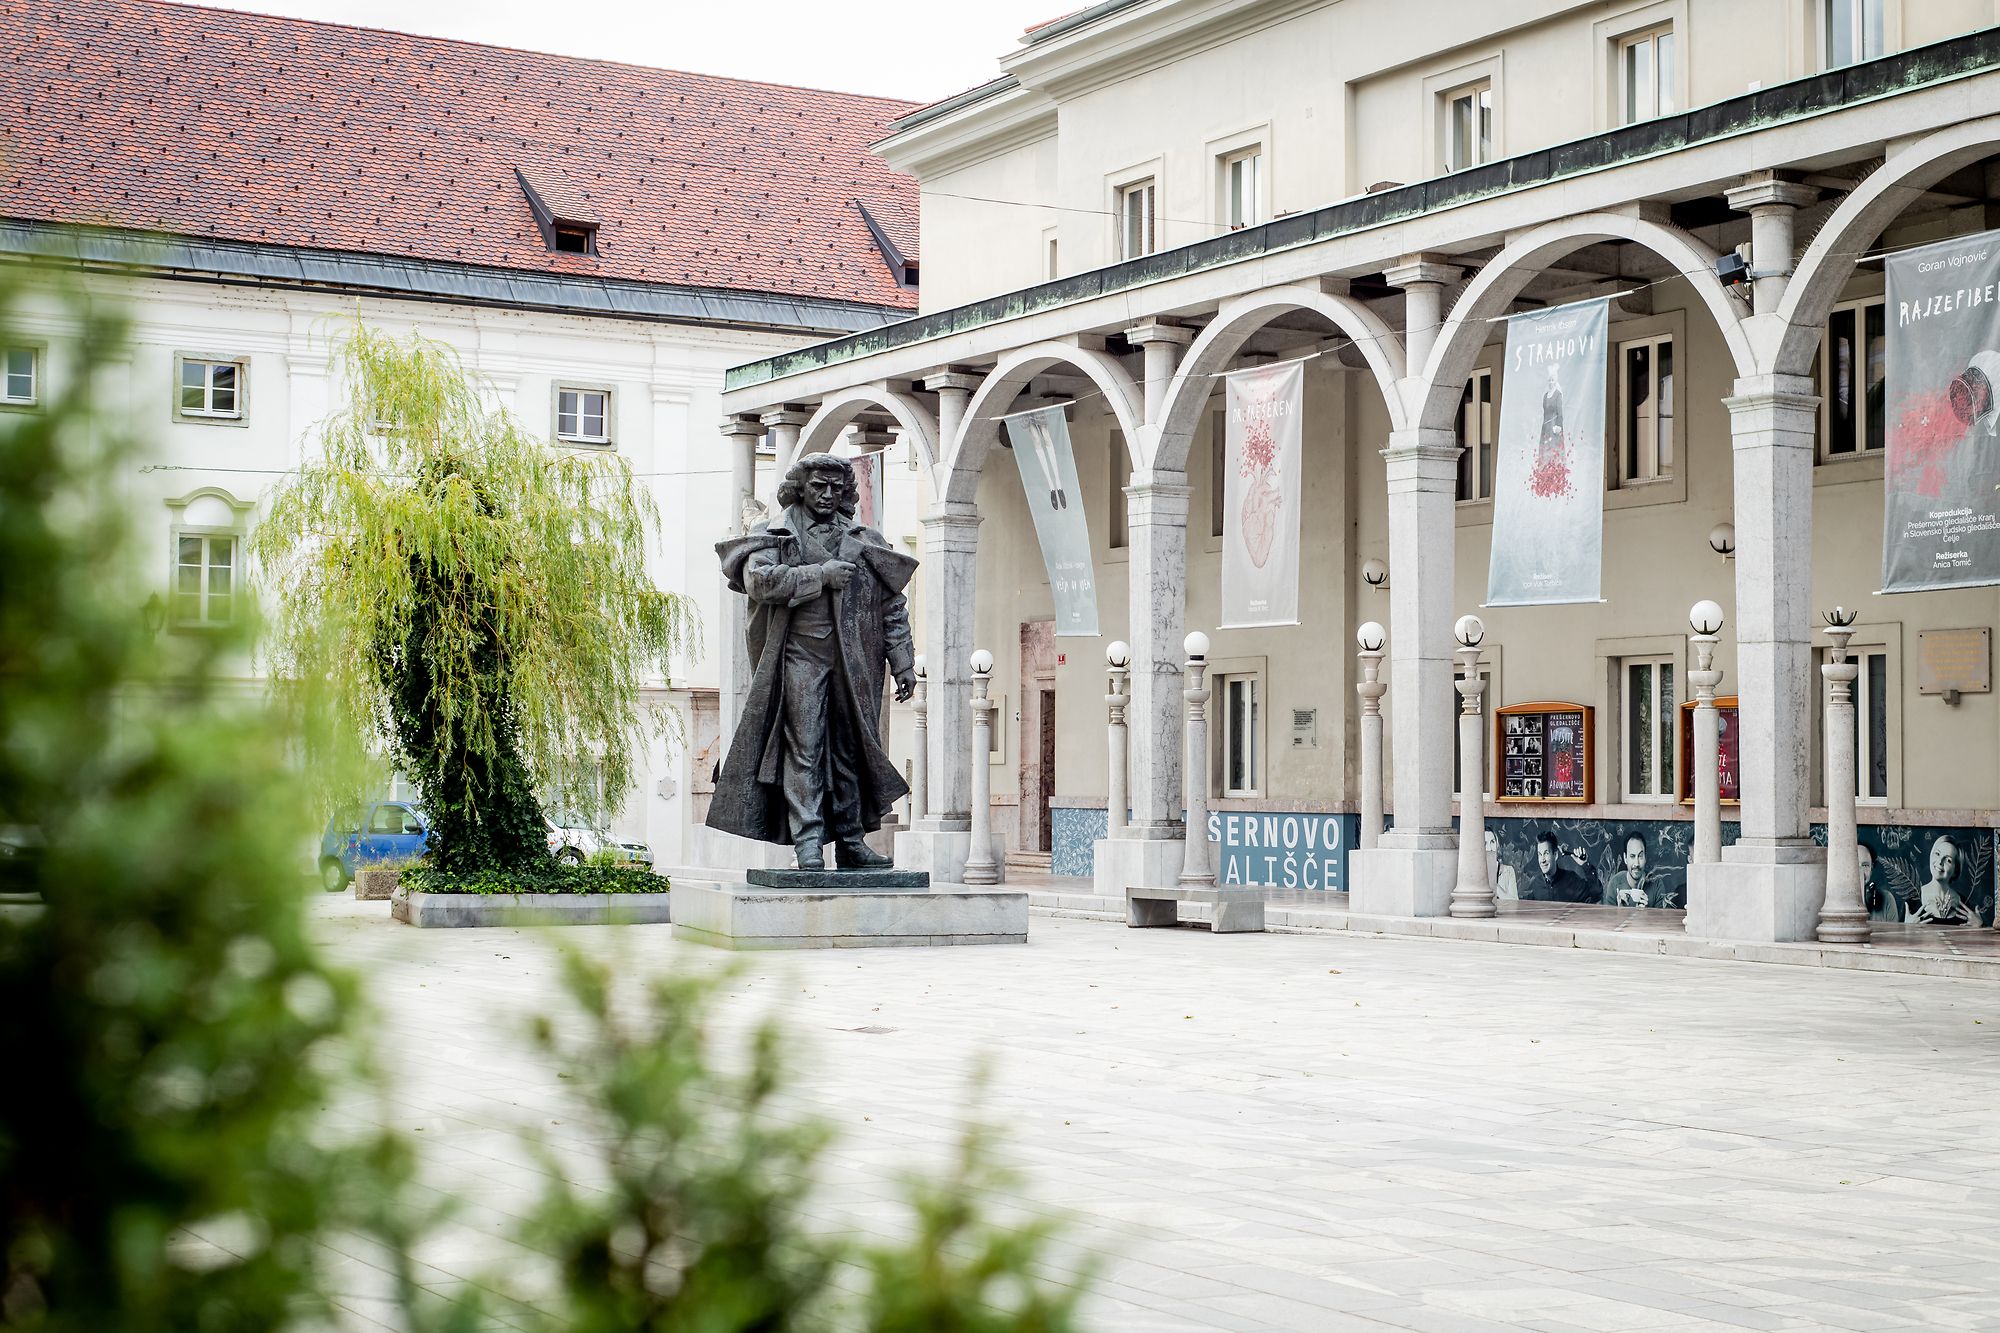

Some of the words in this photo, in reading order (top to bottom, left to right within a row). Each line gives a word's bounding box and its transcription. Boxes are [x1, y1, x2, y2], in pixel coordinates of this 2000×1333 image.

[1918, 260, 1945, 272] Goran
[1948, 249, 1987, 267] Vojnović
[1899, 281, 2000, 328] RAJZEFIBE
[1515, 335, 1594, 372] STRAHOVI
[1907, 520, 1943, 529] Prešernovo
[1944, 515, 1977, 527] gledališče
[1978, 513, 1995, 522] Kranj
[1929, 507, 1972, 519] Koprodukcija
[1903, 530, 1909, 538] in
[1910, 528, 1942, 538] Slovensko
[1943, 525, 1966, 536] ljudsko
[1943, 535, 1960, 543] Celje
[1936, 551, 1968, 560] Režiserka
[1952, 558, 1972, 567] Tomić
[1208, 811, 1339, 850] ŠERNOVO
[1225, 851, 1338, 891] ALIŠČE
